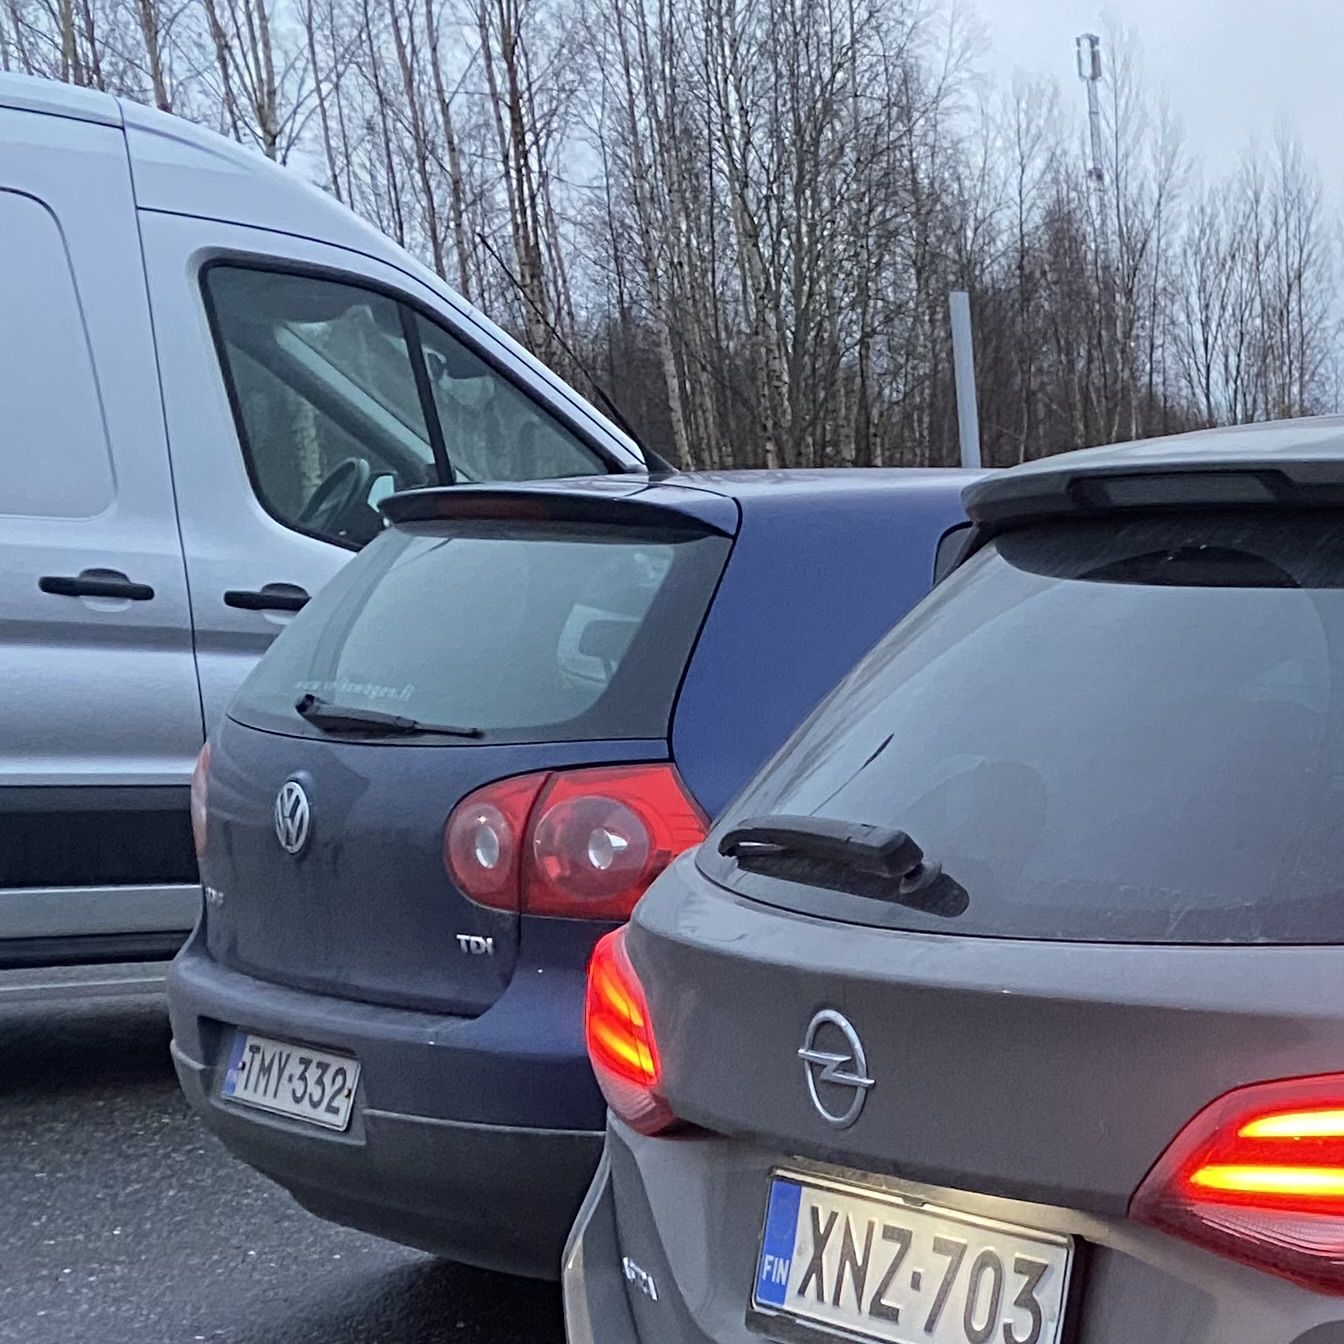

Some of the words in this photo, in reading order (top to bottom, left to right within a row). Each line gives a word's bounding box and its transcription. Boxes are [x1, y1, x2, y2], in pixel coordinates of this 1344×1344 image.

[456, 934, 493, 955] TDI
[243, 1044, 347, 1115] TMY-332
[761, 1254, 790, 1285] FIN
